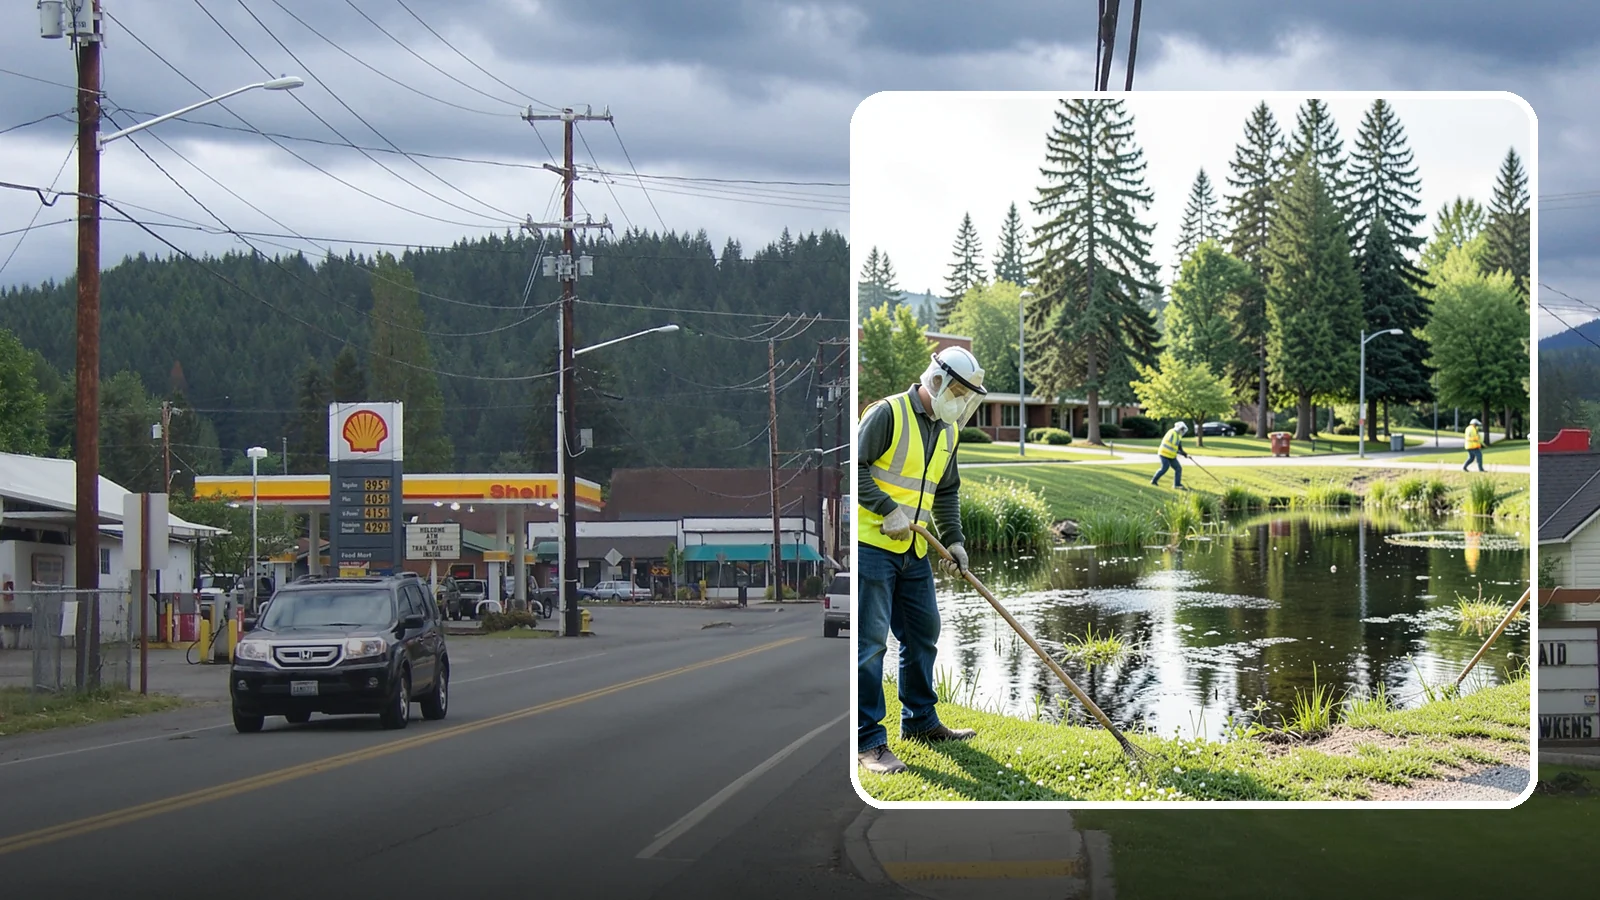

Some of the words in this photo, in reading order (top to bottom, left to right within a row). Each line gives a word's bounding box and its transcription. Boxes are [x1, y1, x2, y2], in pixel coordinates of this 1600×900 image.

[366, 480, 383, 490] 395
[490, 484, 547, 499] Shell
[365, 494, 383, 504] 405
[365, 508, 383, 518] 415
[365, 522, 383, 532] 429
